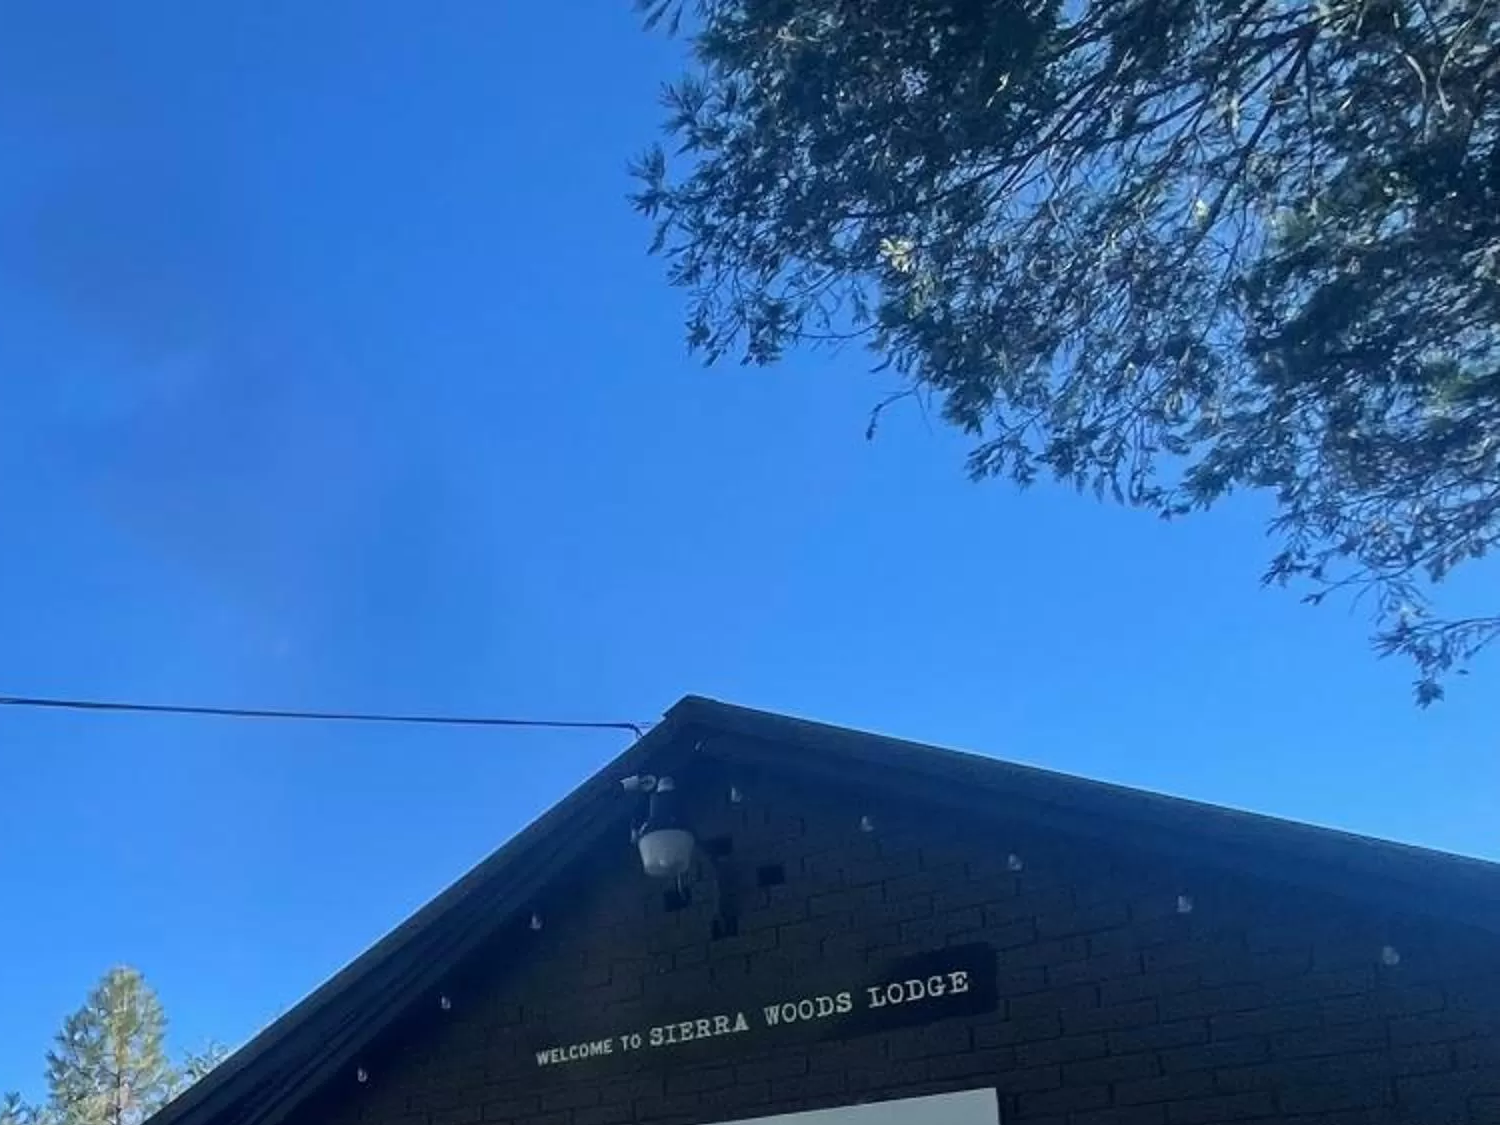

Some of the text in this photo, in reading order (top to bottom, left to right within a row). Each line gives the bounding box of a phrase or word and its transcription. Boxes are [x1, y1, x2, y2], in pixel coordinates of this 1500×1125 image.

[535, 971, 969, 1066] WELCOME TO SIERRA WOODS LODGE
